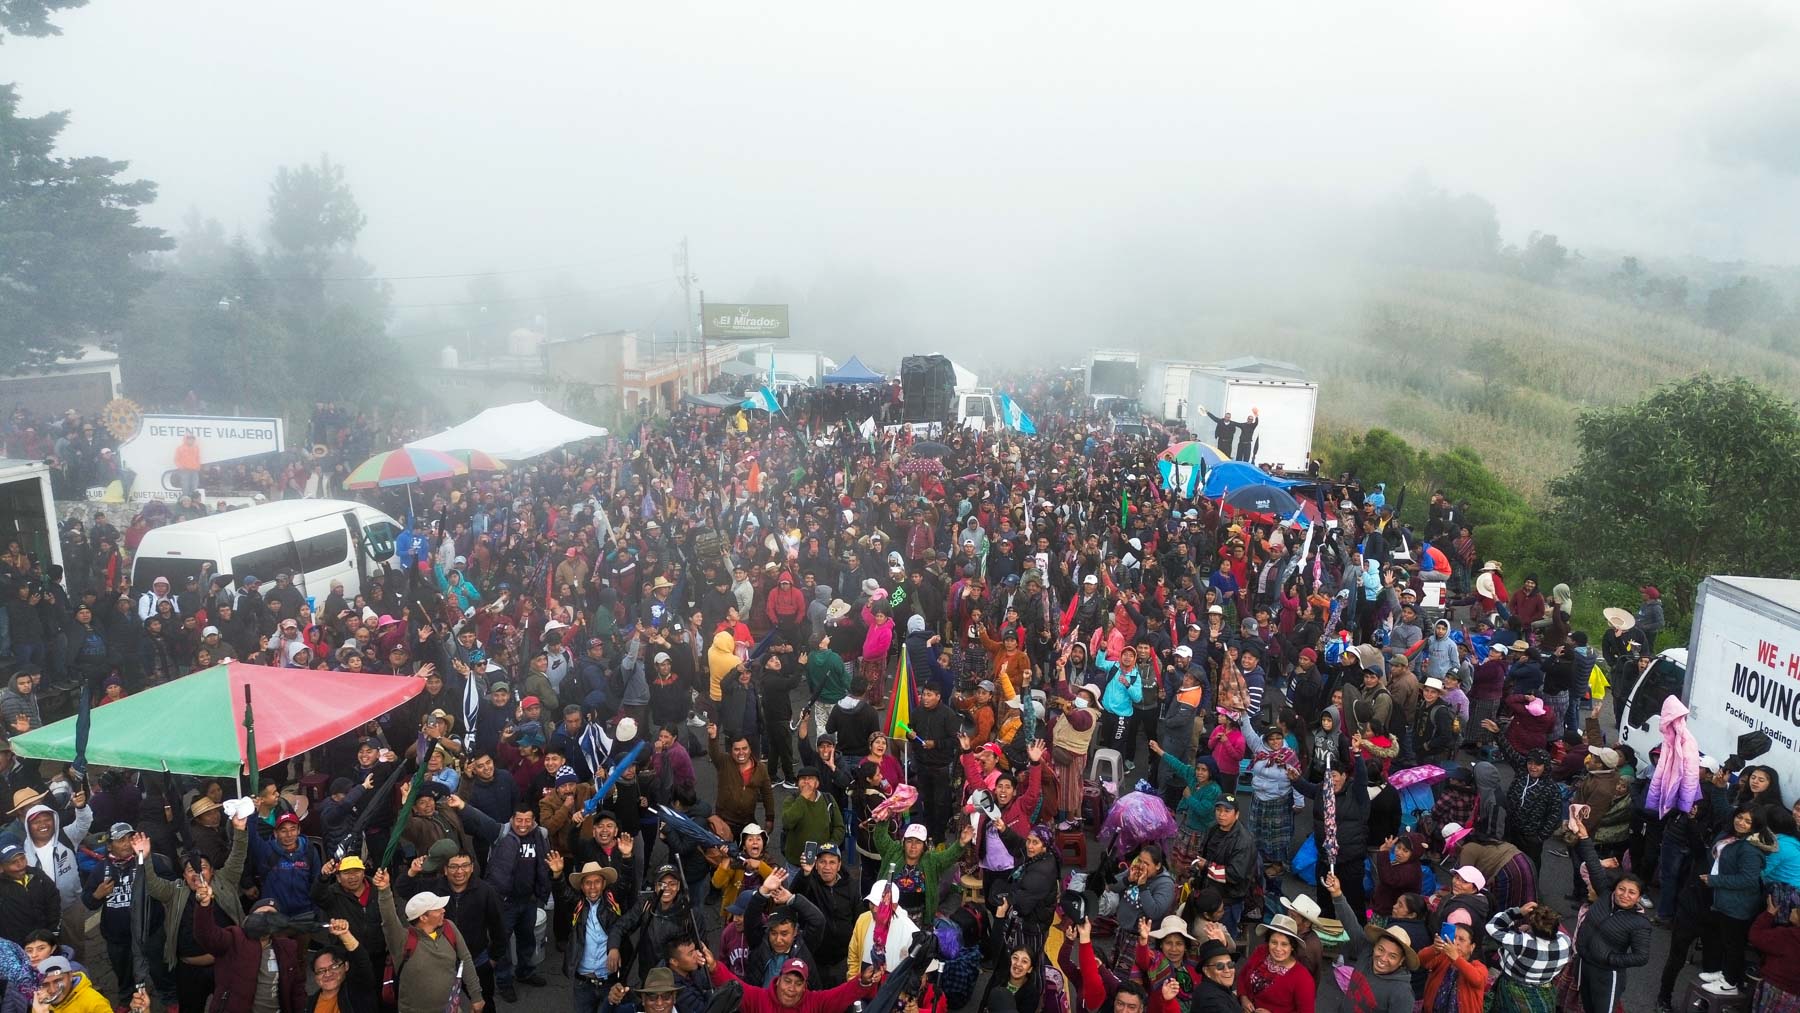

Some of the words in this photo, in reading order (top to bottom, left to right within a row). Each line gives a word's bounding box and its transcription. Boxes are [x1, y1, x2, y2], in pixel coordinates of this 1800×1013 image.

[720, 316, 731, 325] El
[734, 317, 775, 327] Mirador
[150, 425, 212, 438] DETENTE
[217, 427, 273, 440] VIAJERO
[1757, 639, 1779, 669] WE
[1731, 662, 1800, 727] MOVING
[1622, 725, 1629, 741] 3
[1725, 702, 1755, 728] Packing
[1760, 721, 1792, 749] Loading
